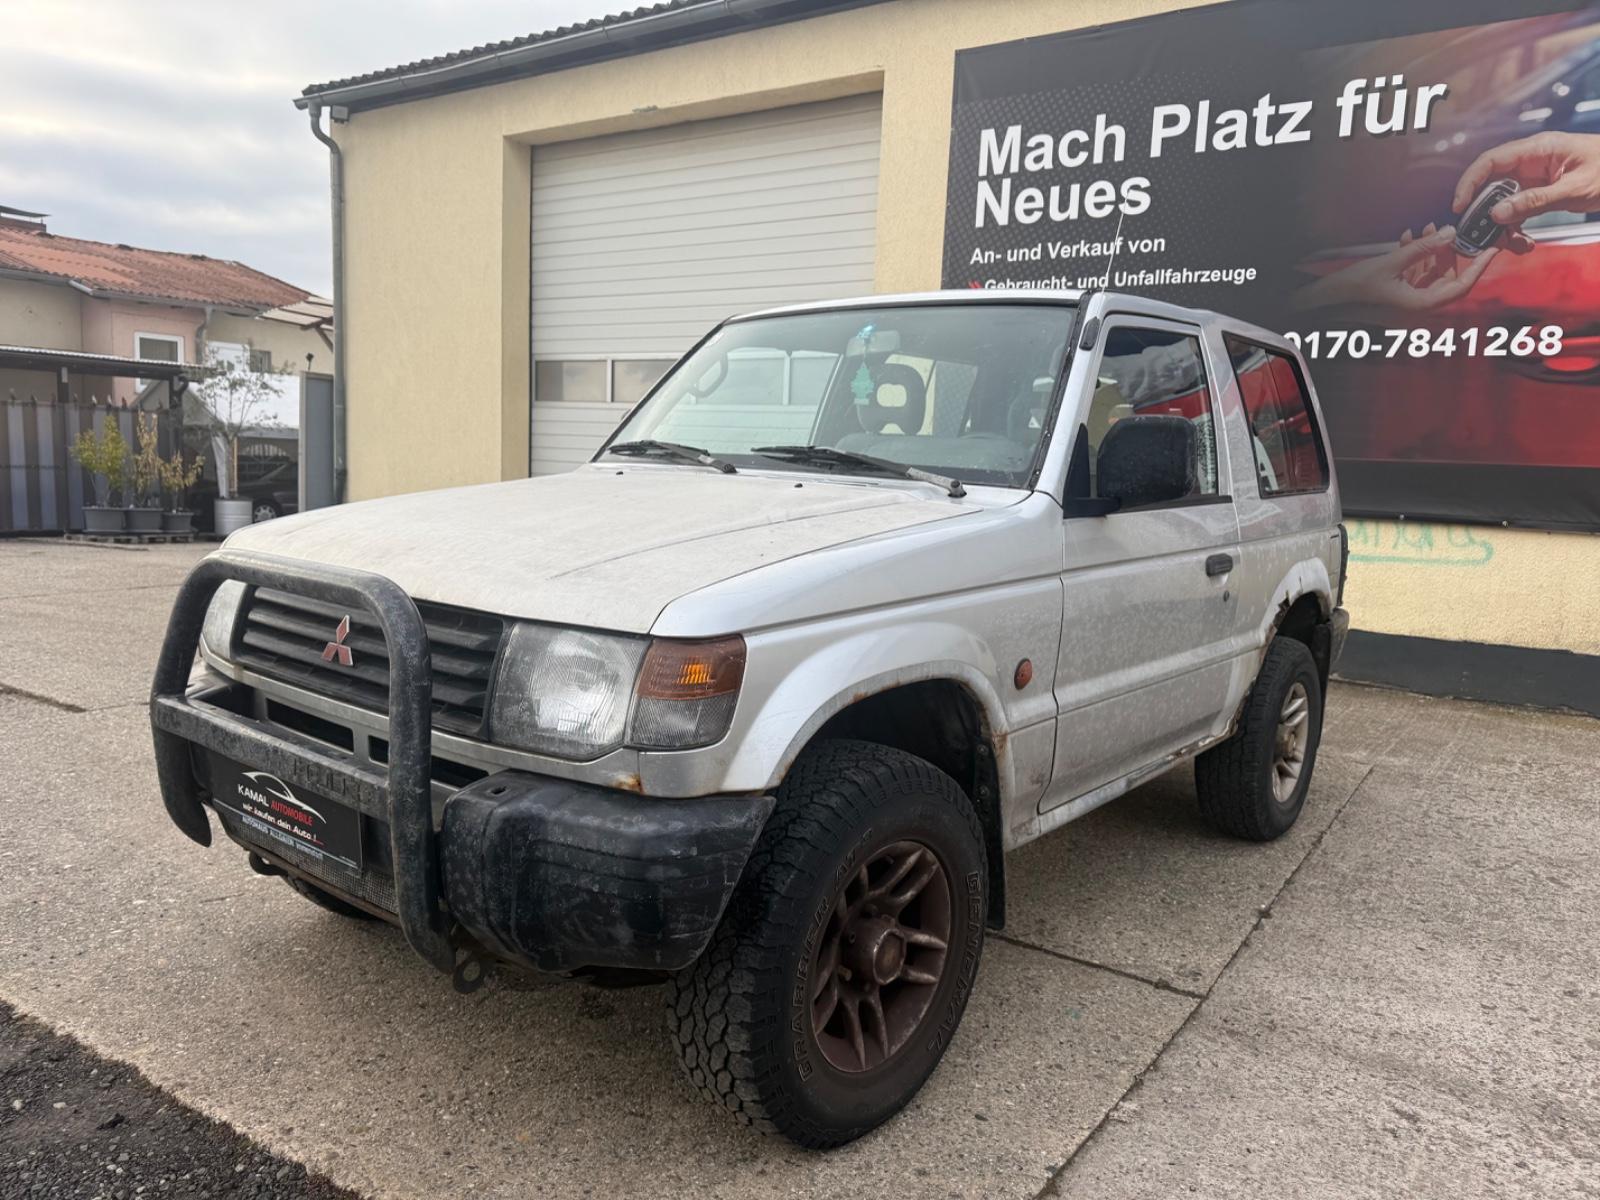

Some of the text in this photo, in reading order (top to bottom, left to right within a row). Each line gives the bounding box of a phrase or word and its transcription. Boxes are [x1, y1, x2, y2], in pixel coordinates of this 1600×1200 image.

[977, 74, 1448, 177] Mach Platz für
[974, 175, 1152, 228] Neues
[970, 236, 1166, 265] An- und Verkauf von
[1077, 271, 1109, 288] und
[1114, 266, 1257, 287] Unfallfahrzeuge
[237, 783, 314, 827] KAMAL AUTOMOBILE
[927, 871, 983, 1051] GENERAL
